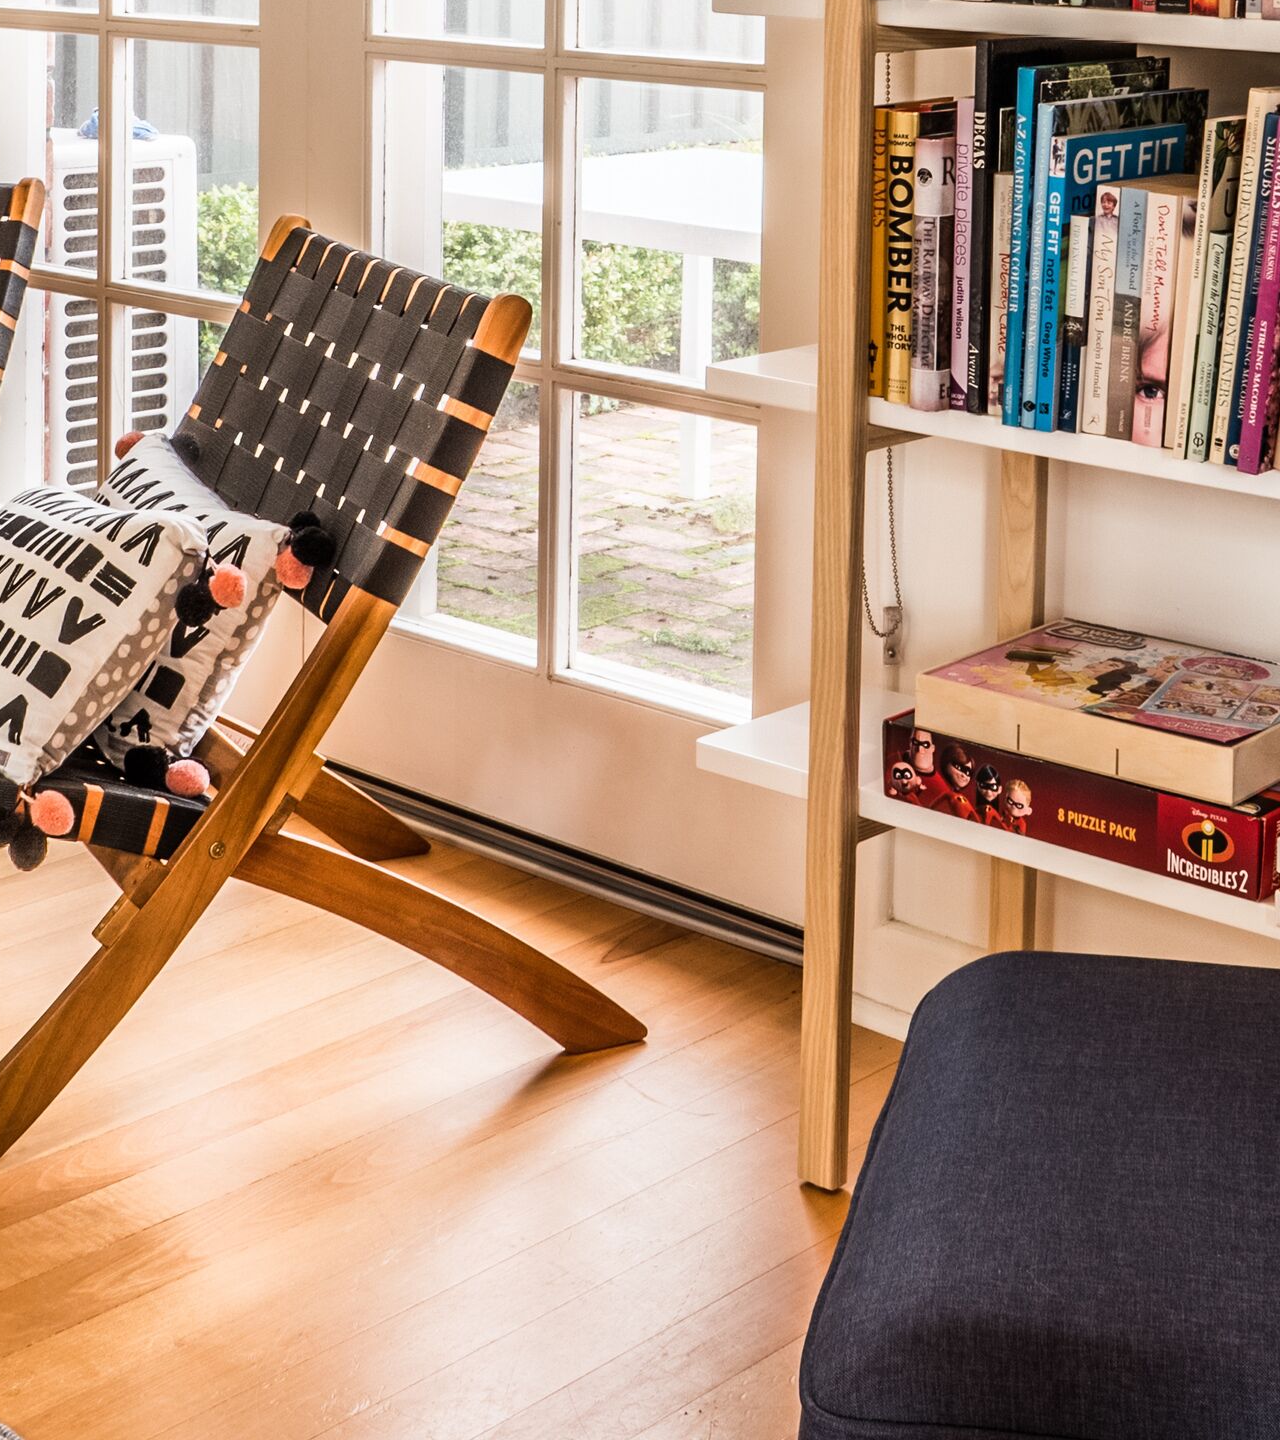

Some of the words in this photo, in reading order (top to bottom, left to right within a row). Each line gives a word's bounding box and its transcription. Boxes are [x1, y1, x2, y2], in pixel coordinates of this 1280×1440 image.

[973, 111, 986, 169] DEGAS
[955, 144, 971, 201] private
[1072, 148, 1130, 185] GET
[1133, 137, 1178, 176] FIT
[1203, 145, 1211, 176] ULTIMATE
[1048, 192, 1061, 226] GET
[1201, 202, 1206, 211] OF
[887, 154, 913, 313] BOMBER
[954, 208, 970, 266] places
[1047, 230, 1059, 254] FIT
[1195, 214, 1205, 256] GARDENING
[1045, 259, 1058, 285] not
[955, 276, 965, 304] judith
[1043, 290, 1057, 312] fat
[889, 324, 906, 332] THE
[955, 308, 964, 340] wilson
[887, 341, 911, 350] STORY
[968, 342, 980, 388] Avenel
[1058, 808, 1065, 823] 8
[1067, 811, 1106, 834] PUZZLE
[1109, 821, 1136, 842] PACK
[1191, 807, 1209, 819] Disney
[1210, 813, 1227, 823] PIXAR
[1167, 848, 1238, 890] INCREDIBLES
[1239, 870, 1248, 894] 2
